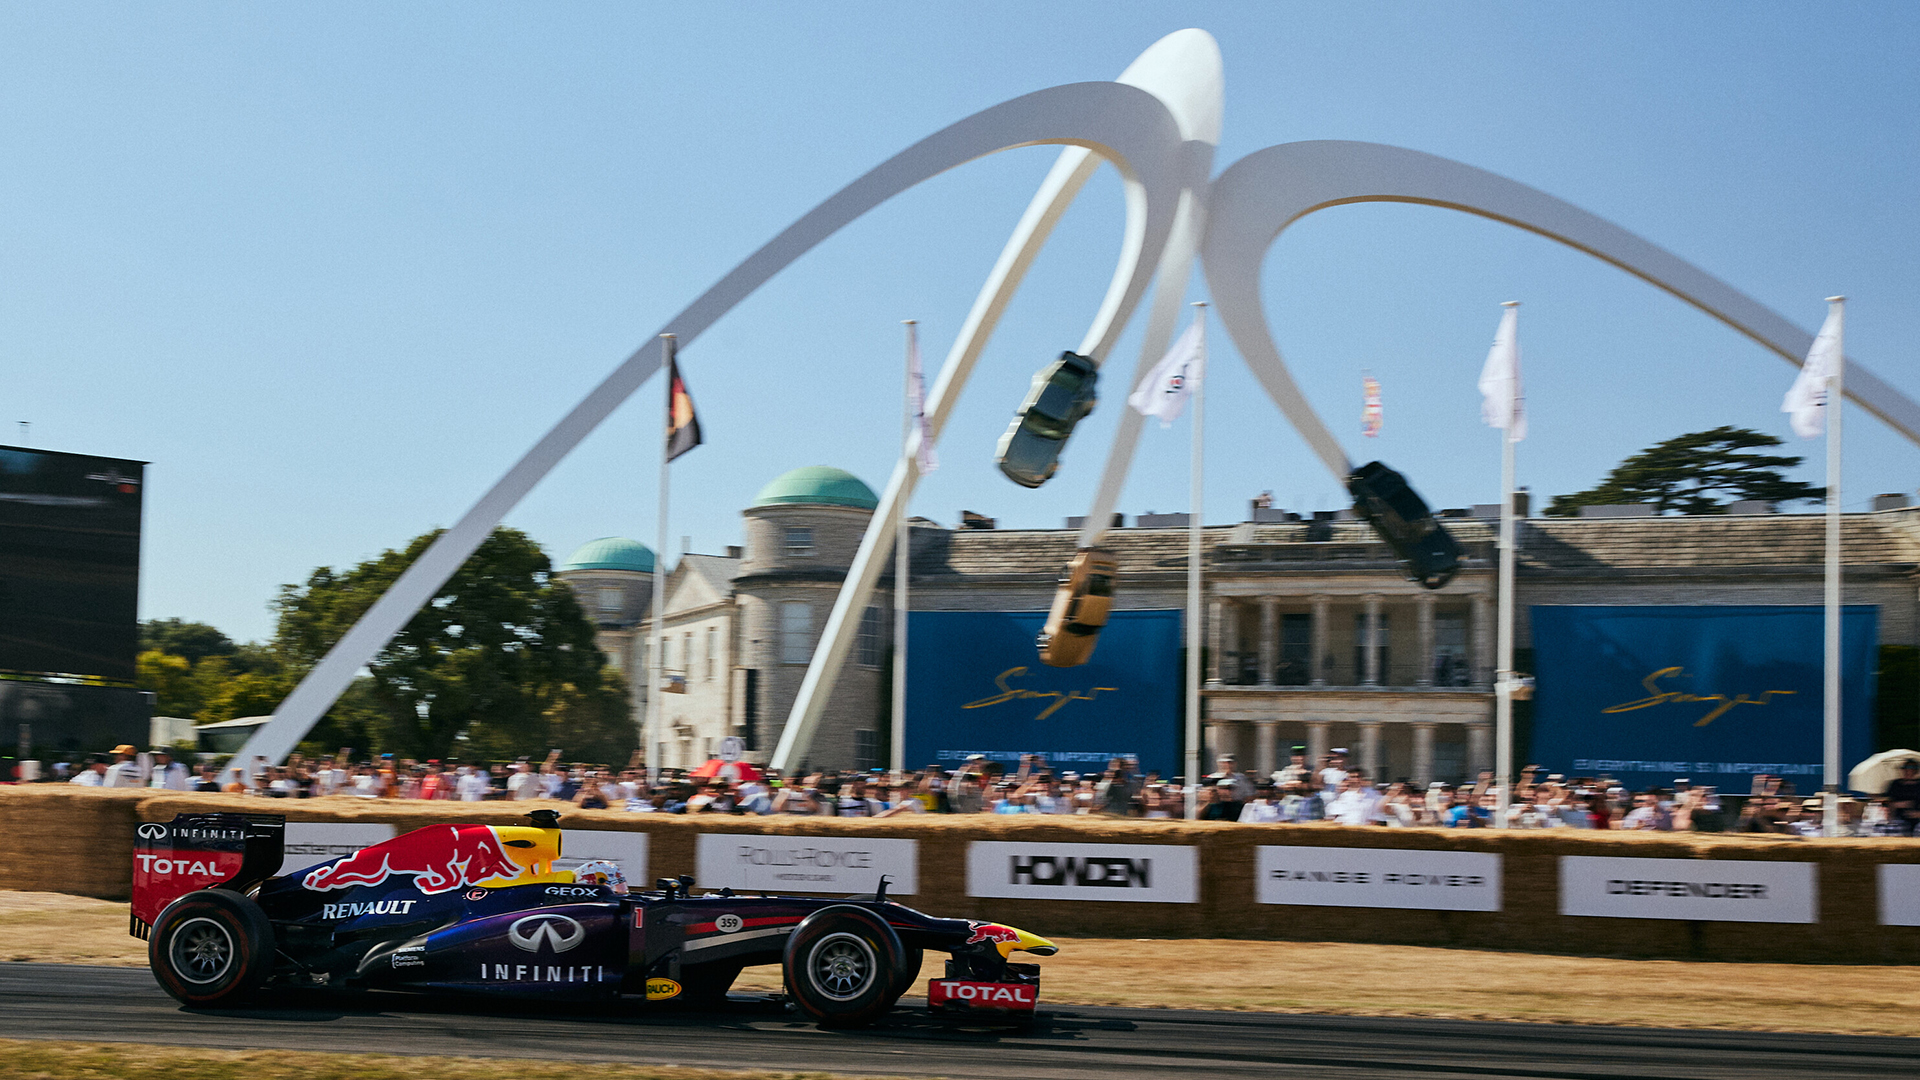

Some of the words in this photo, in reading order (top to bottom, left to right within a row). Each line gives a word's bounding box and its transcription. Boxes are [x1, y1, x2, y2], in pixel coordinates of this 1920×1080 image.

[173, 828, 244, 840] INFINITI
[136, 854, 225, 876] TOTAL
[1010, 855, 1152, 888] HOWDEN
[1269, 869, 1371, 884] RANGE
[1383, 873, 1486, 887] ROVER
[544, 886, 600, 897] GEOX
[1606, 879, 1769, 900] DEFENDER
[322, 900, 417, 920] RENAULT
[634, 907, 643, 928] 1
[720, 918, 738, 928] 359
[481, 963, 603, 982] INFINITI
[647, 984, 675, 994] RAUCH
[940, 982, 1031, 1003] TOTAL
